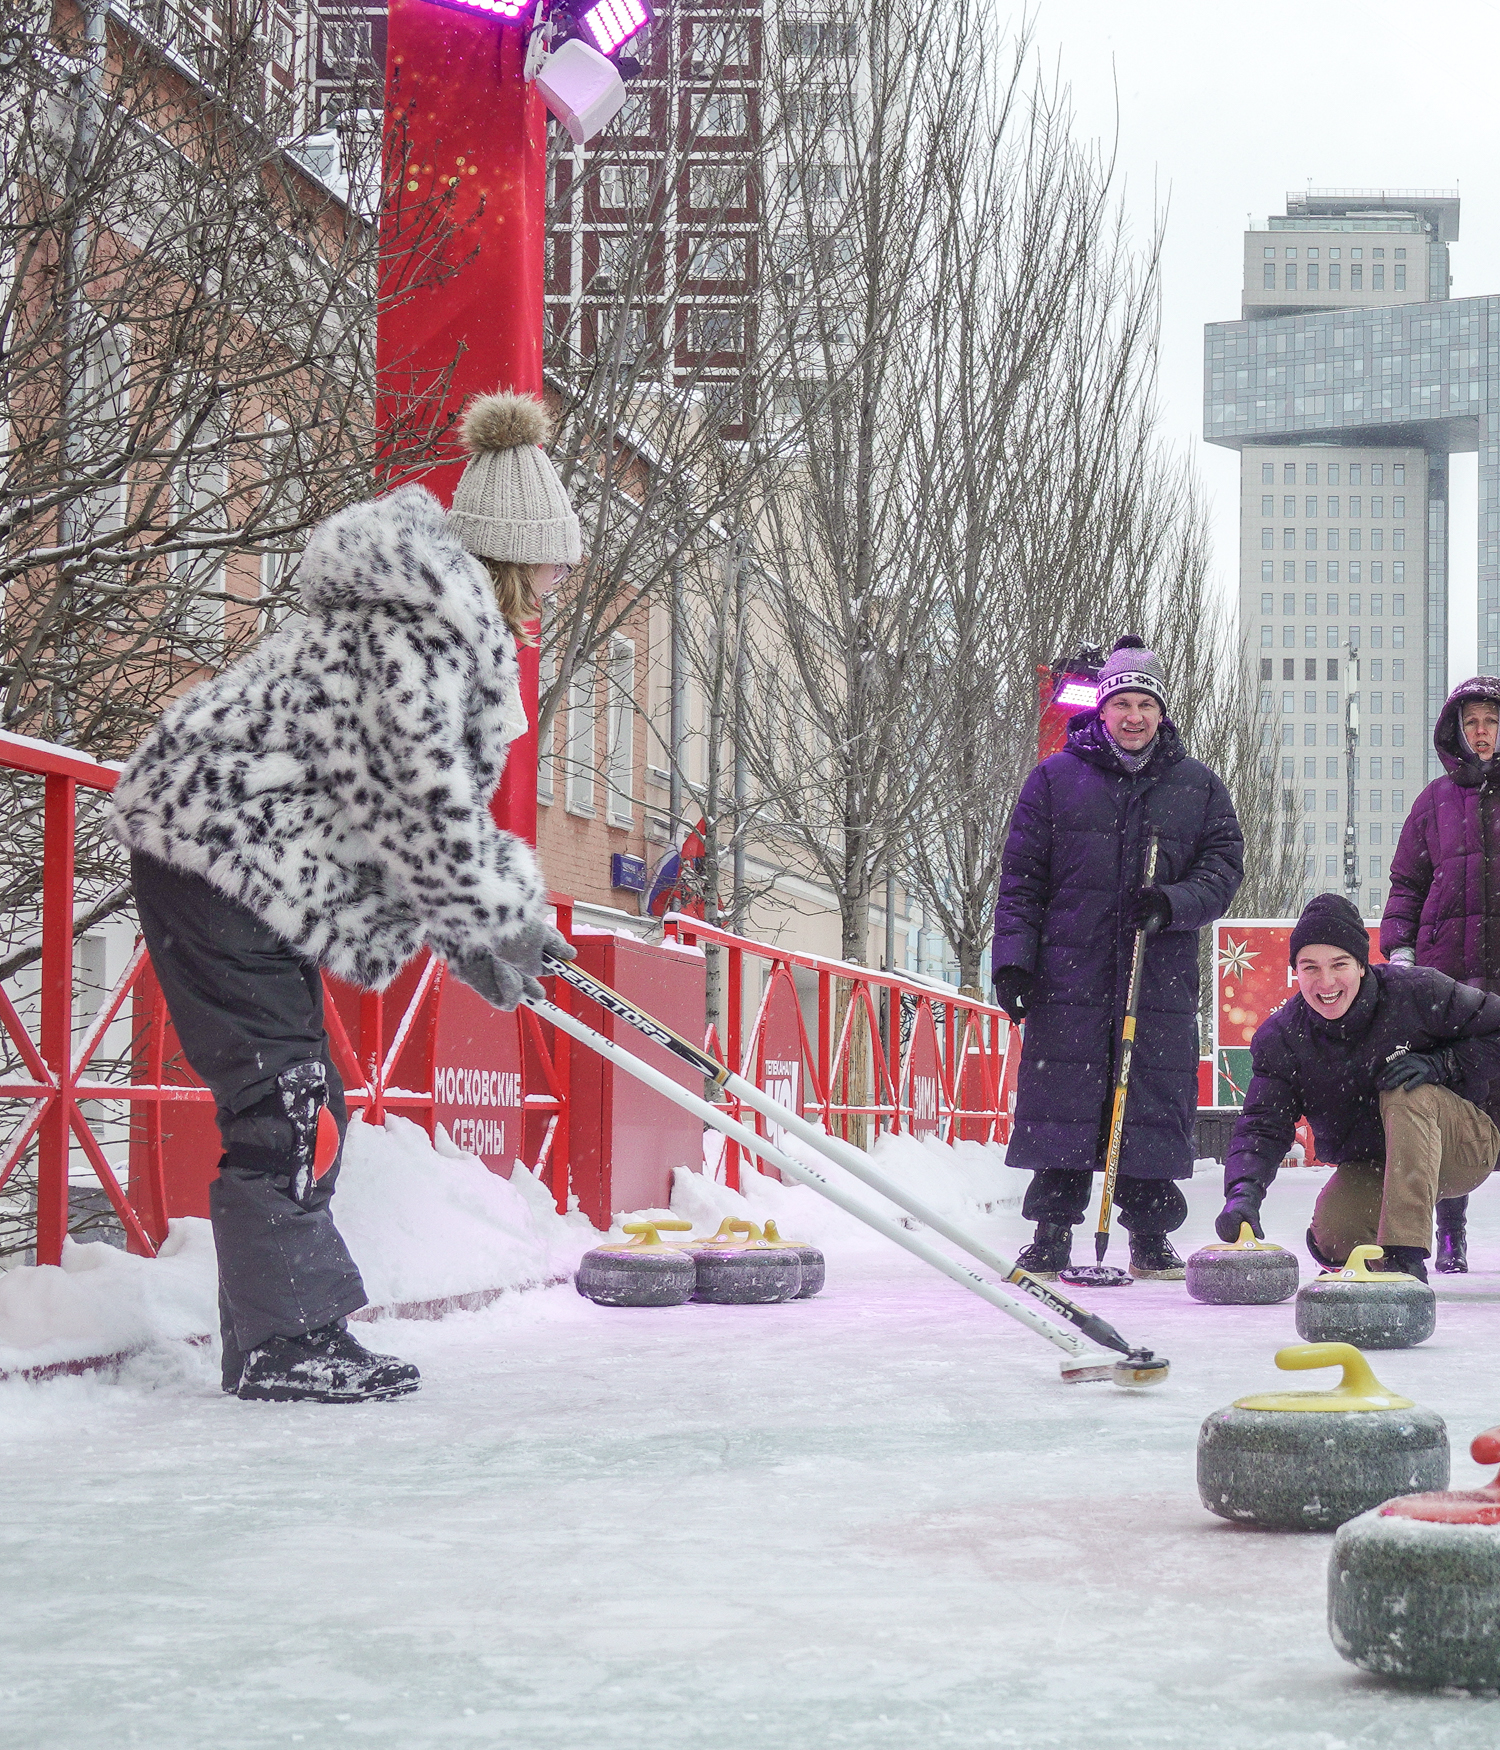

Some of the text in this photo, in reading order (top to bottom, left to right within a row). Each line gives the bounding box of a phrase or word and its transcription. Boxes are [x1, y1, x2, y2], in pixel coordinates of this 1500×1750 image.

[434, 1066, 521, 1107] МОСКОВСКИЕ
[452, 1118, 505, 1155] СЕЗОНЫ
[1343, 1270, 1354, 1278] D
